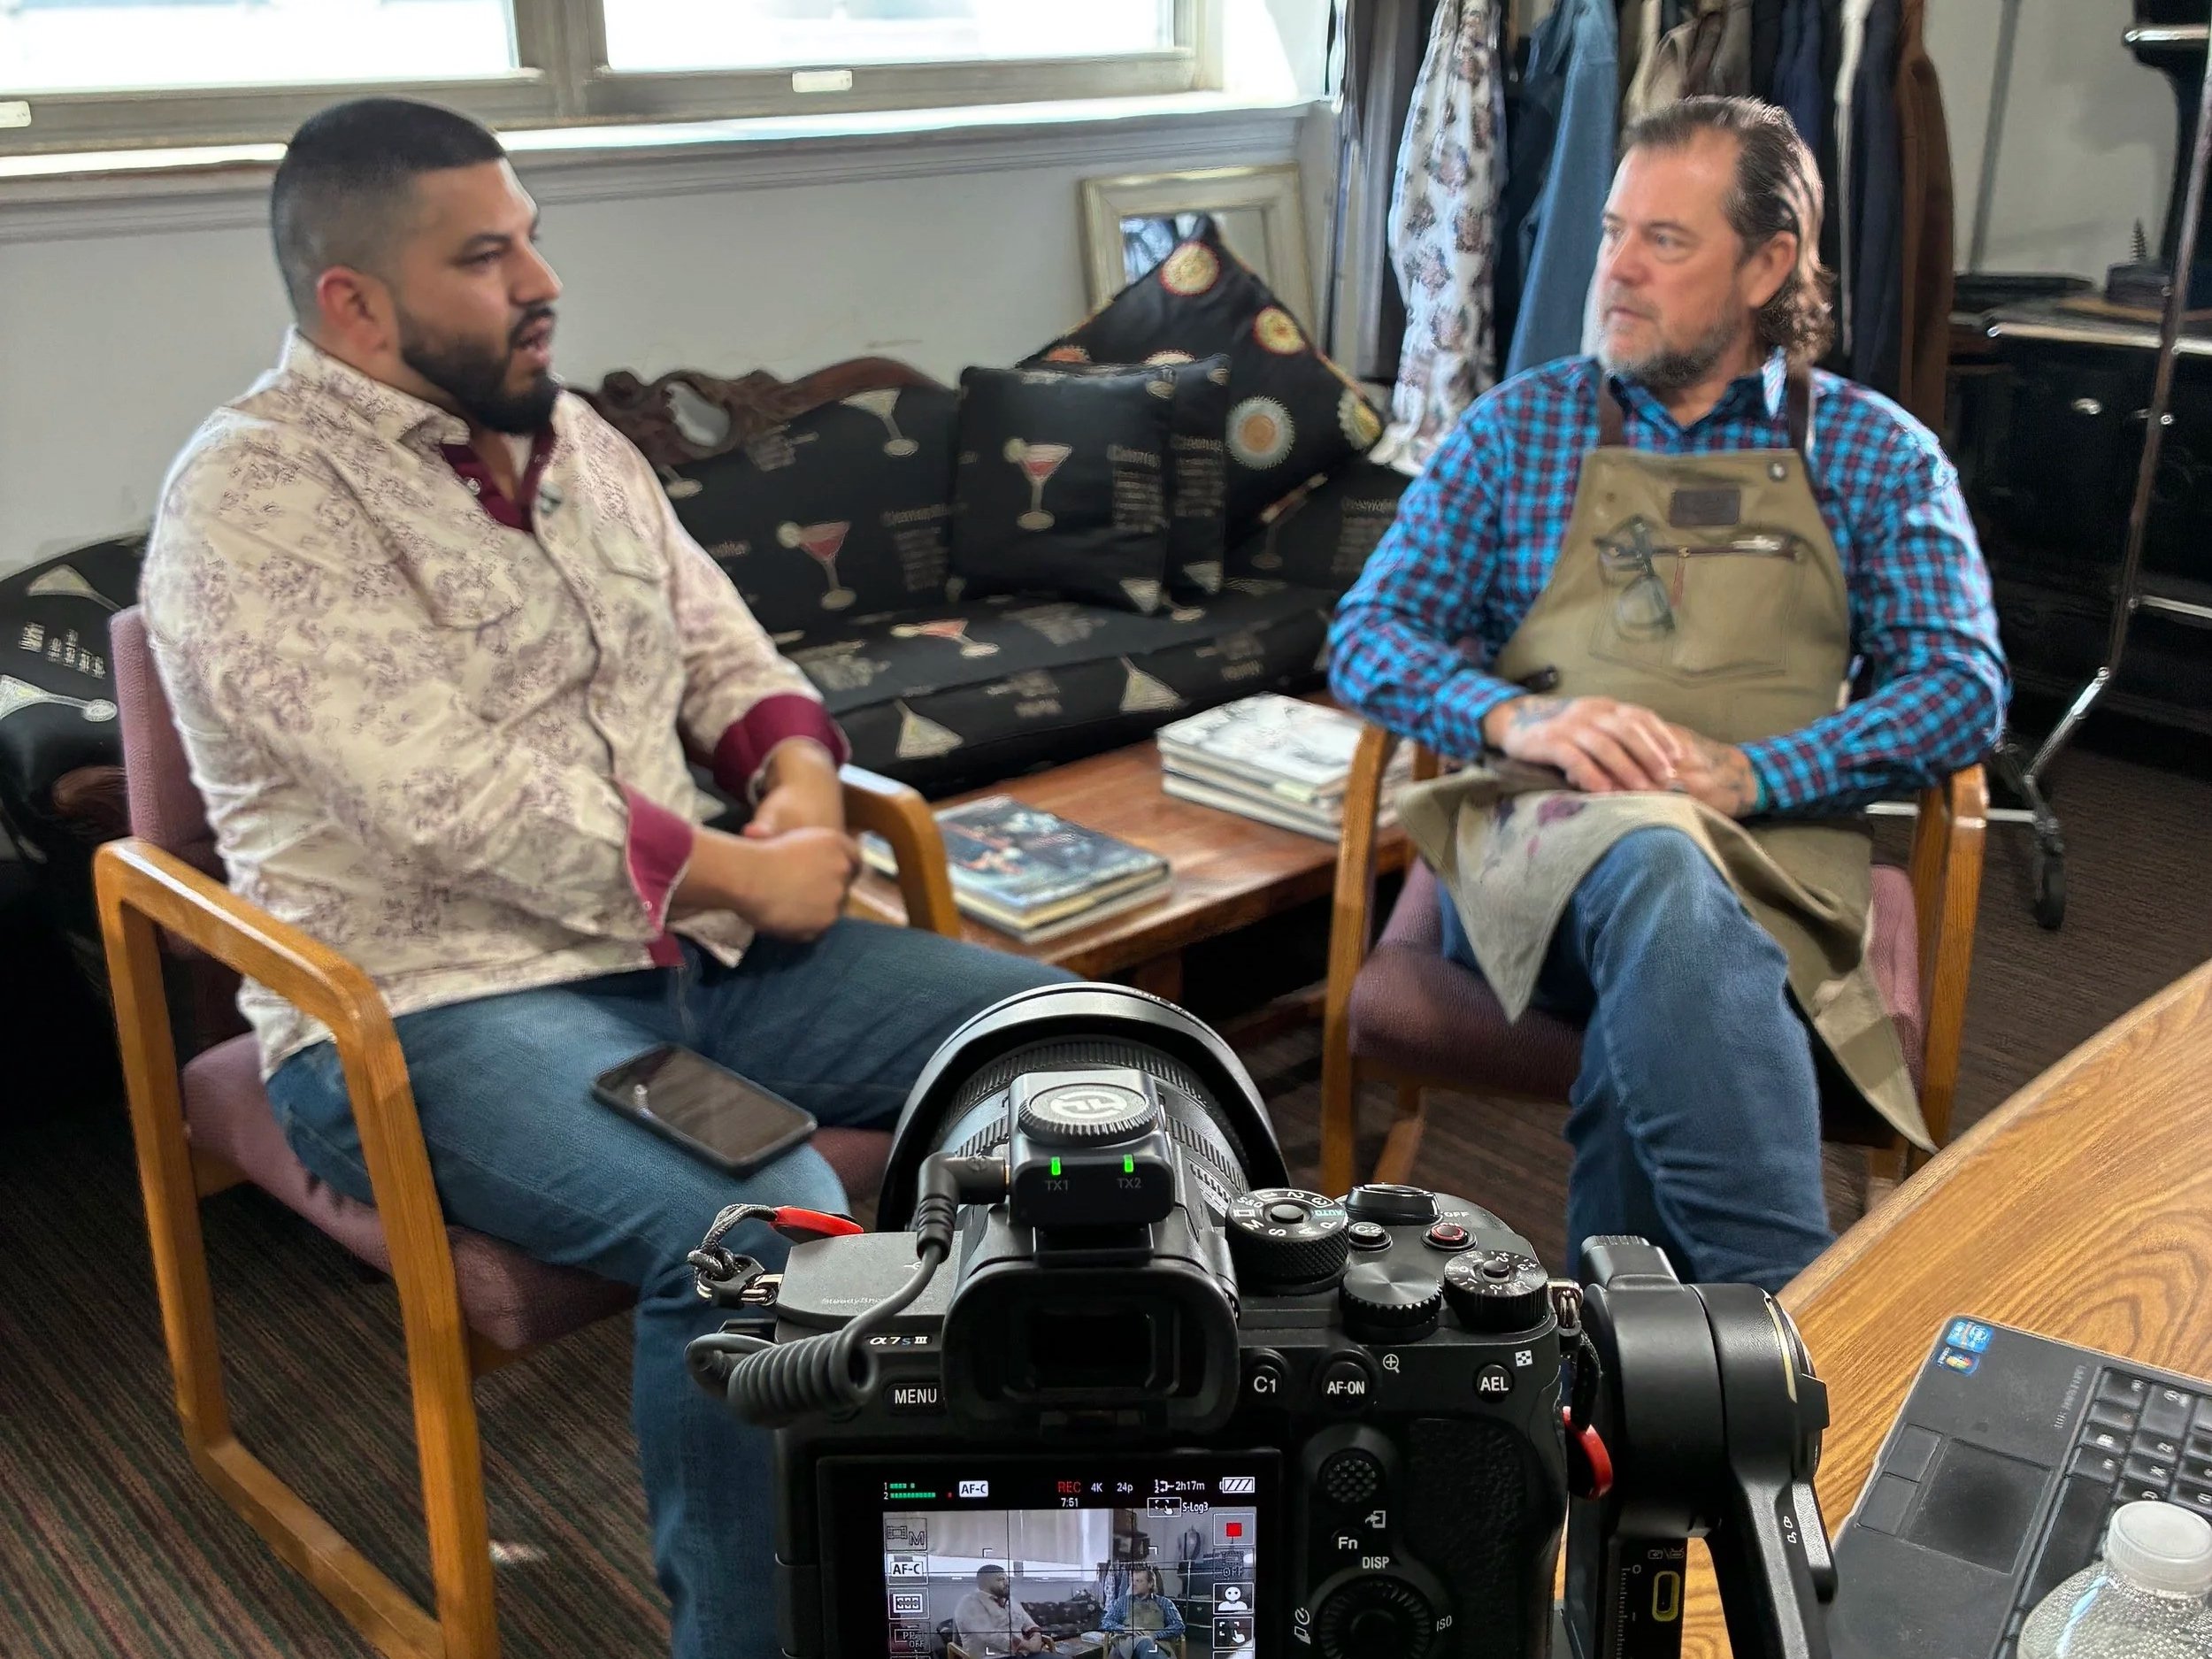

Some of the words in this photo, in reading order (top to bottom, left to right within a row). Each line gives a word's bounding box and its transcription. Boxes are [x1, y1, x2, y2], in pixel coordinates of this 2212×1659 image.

[1044, 1179, 1069, 1191] TX1
[1117, 1178, 1142, 1189] TX2
[1311, 1196, 1327, 1207] 3
[1241, 1219, 1264, 1230] M
[1355, 1225, 1382, 1234] C2
[1269, 1228, 1286, 1237] S
[1254, 1376, 1277, 1394] C1
[1327, 1381, 1365, 1394] AF-ON
[1479, 1377, 1509, 1393] AEL
[895, 1388, 937, 1404] MENU
[961, 1483, 987, 1494] AF-C
[1057, 1481, 1082, 1494] REC
[1090, 1482, 1103, 1494] 4K
[1117, 1482, 1133, 1494] 24p
[1175, 1480, 1205, 1491] 2h17m
[909, 1532, 925, 1546] M
[1338, 1536, 1358, 1551] Fn
[893, 1563, 920, 1575] AF-C
[1362, 1556, 1390, 1570] DISP
[1436, 1615, 1453, 1632] ISO
